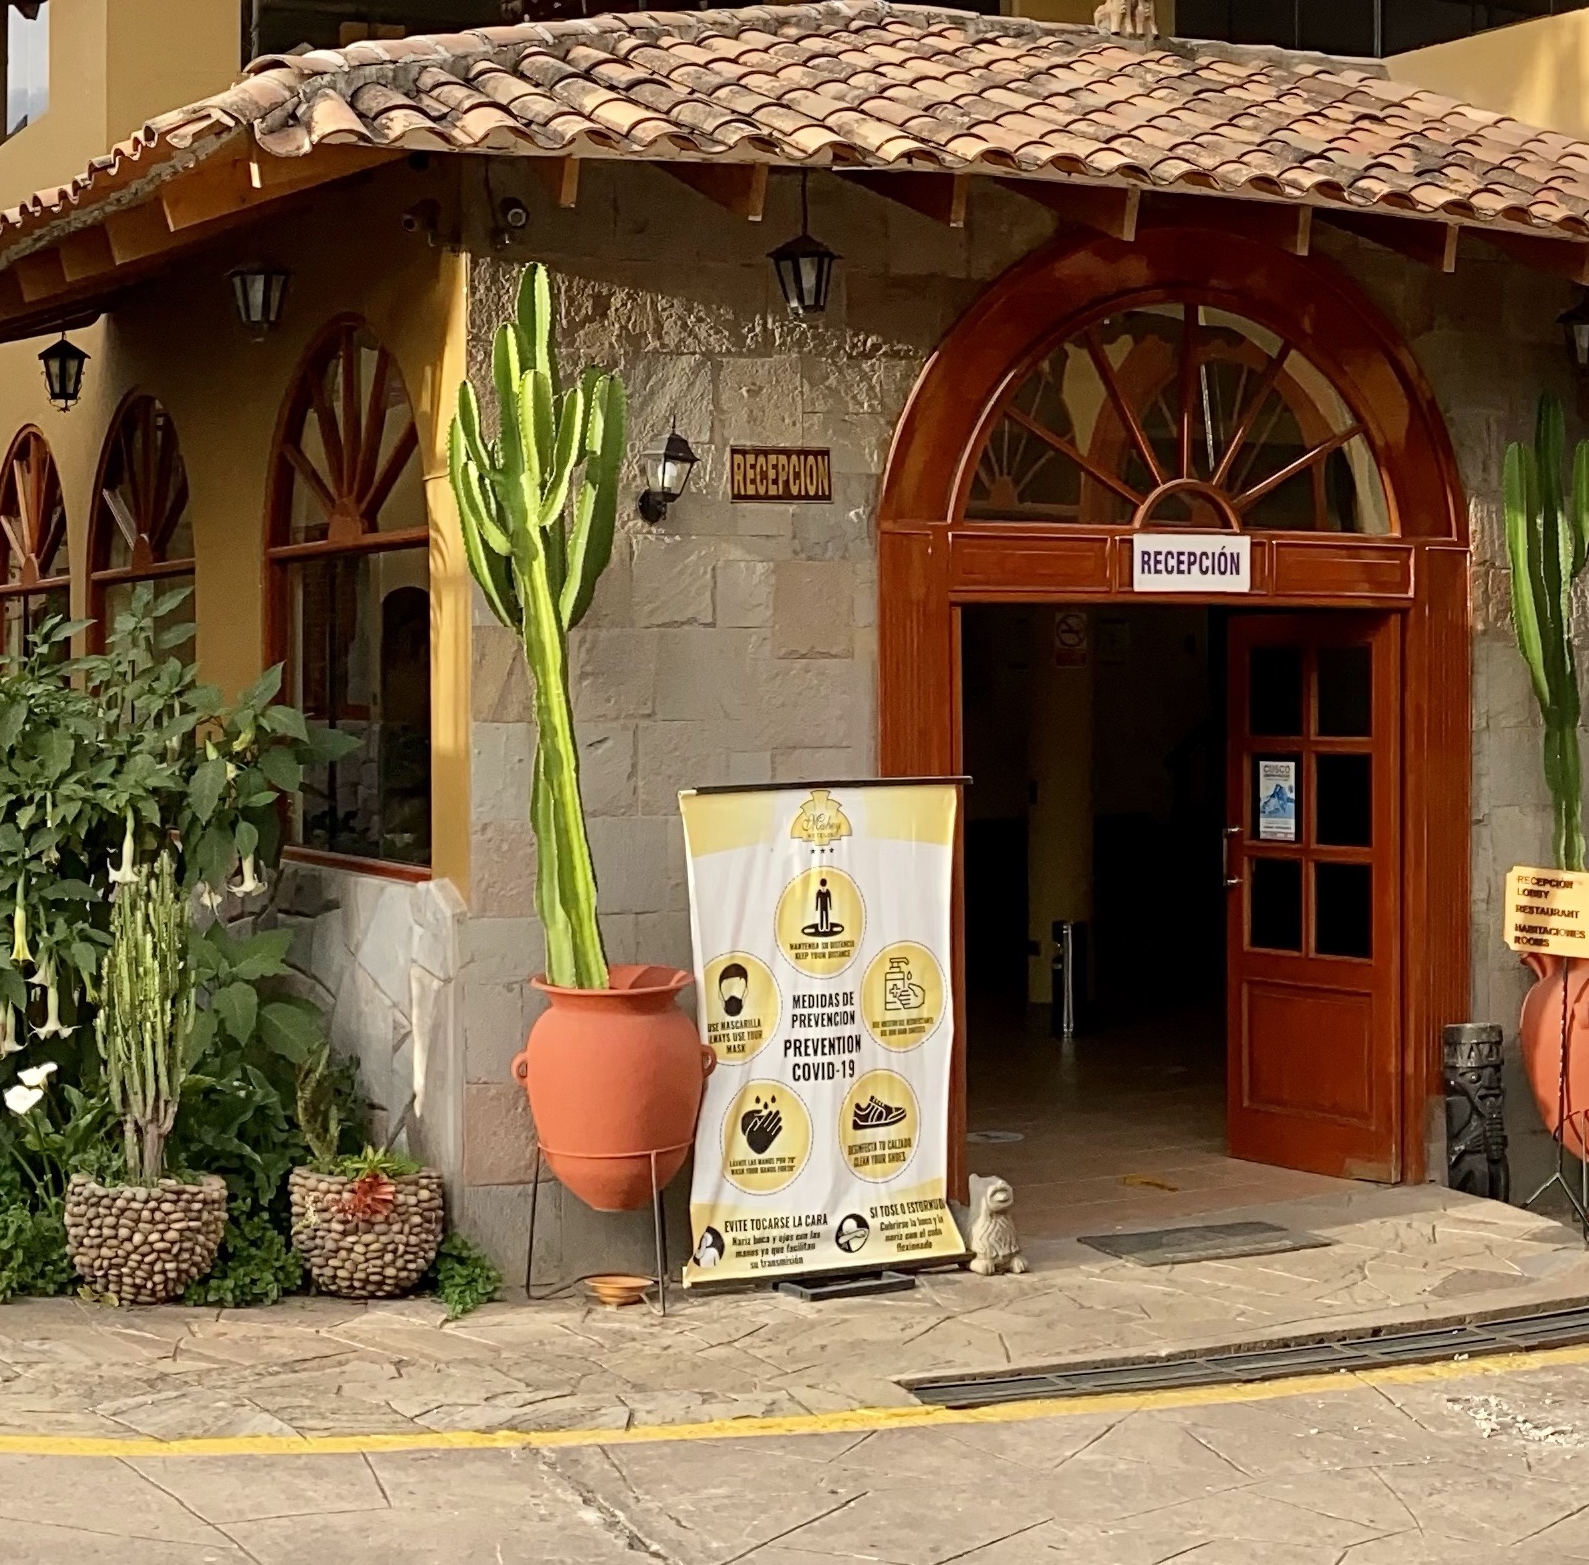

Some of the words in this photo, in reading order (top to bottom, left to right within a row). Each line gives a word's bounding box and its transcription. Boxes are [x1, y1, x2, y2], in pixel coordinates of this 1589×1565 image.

[733, 454, 829, 496] RECEPCION
[1141, 546, 1240, 575] RECEPCIÓN
[1517, 888, 1549, 899] LOBBY
[1515, 904, 1580, 919] RESTAURANT
[1515, 923, 1585, 939] HABITACIONES
[1514, 936, 1549, 947] ROOMS
[792, 993, 840, 1009] MEDIDAS
[842, 991, 854, 1006] DE
[708, 1023, 719, 1032] USE
[721, 1018, 761, 1030] MASCARILLA
[791, 1010, 855, 1028] PREVENCION
[708, 1033, 731, 1044] LWAYS
[733, 1032, 745, 1041] USE
[784, 1034, 861, 1058] PREVENTION
[726, 1044, 745, 1054] MASK
[792, 1059, 855, 1082] COVID-19
[870, 1206, 878, 1219] SI
[880, 1203, 899, 1217] TOSE
[900, 1203, 906, 1214] O
[725, 1219, 747, 1232] EVITE
[750, 1216, 790, 1231] TOCARSE
[793, 1215, 802, 1227] LA
[805, 1213, 828, 1226] CARA
[753, 1235, 769, 1245] boca
[772, 1236, 776, 1244] y
[736, 1249, 758, 1258] manos
